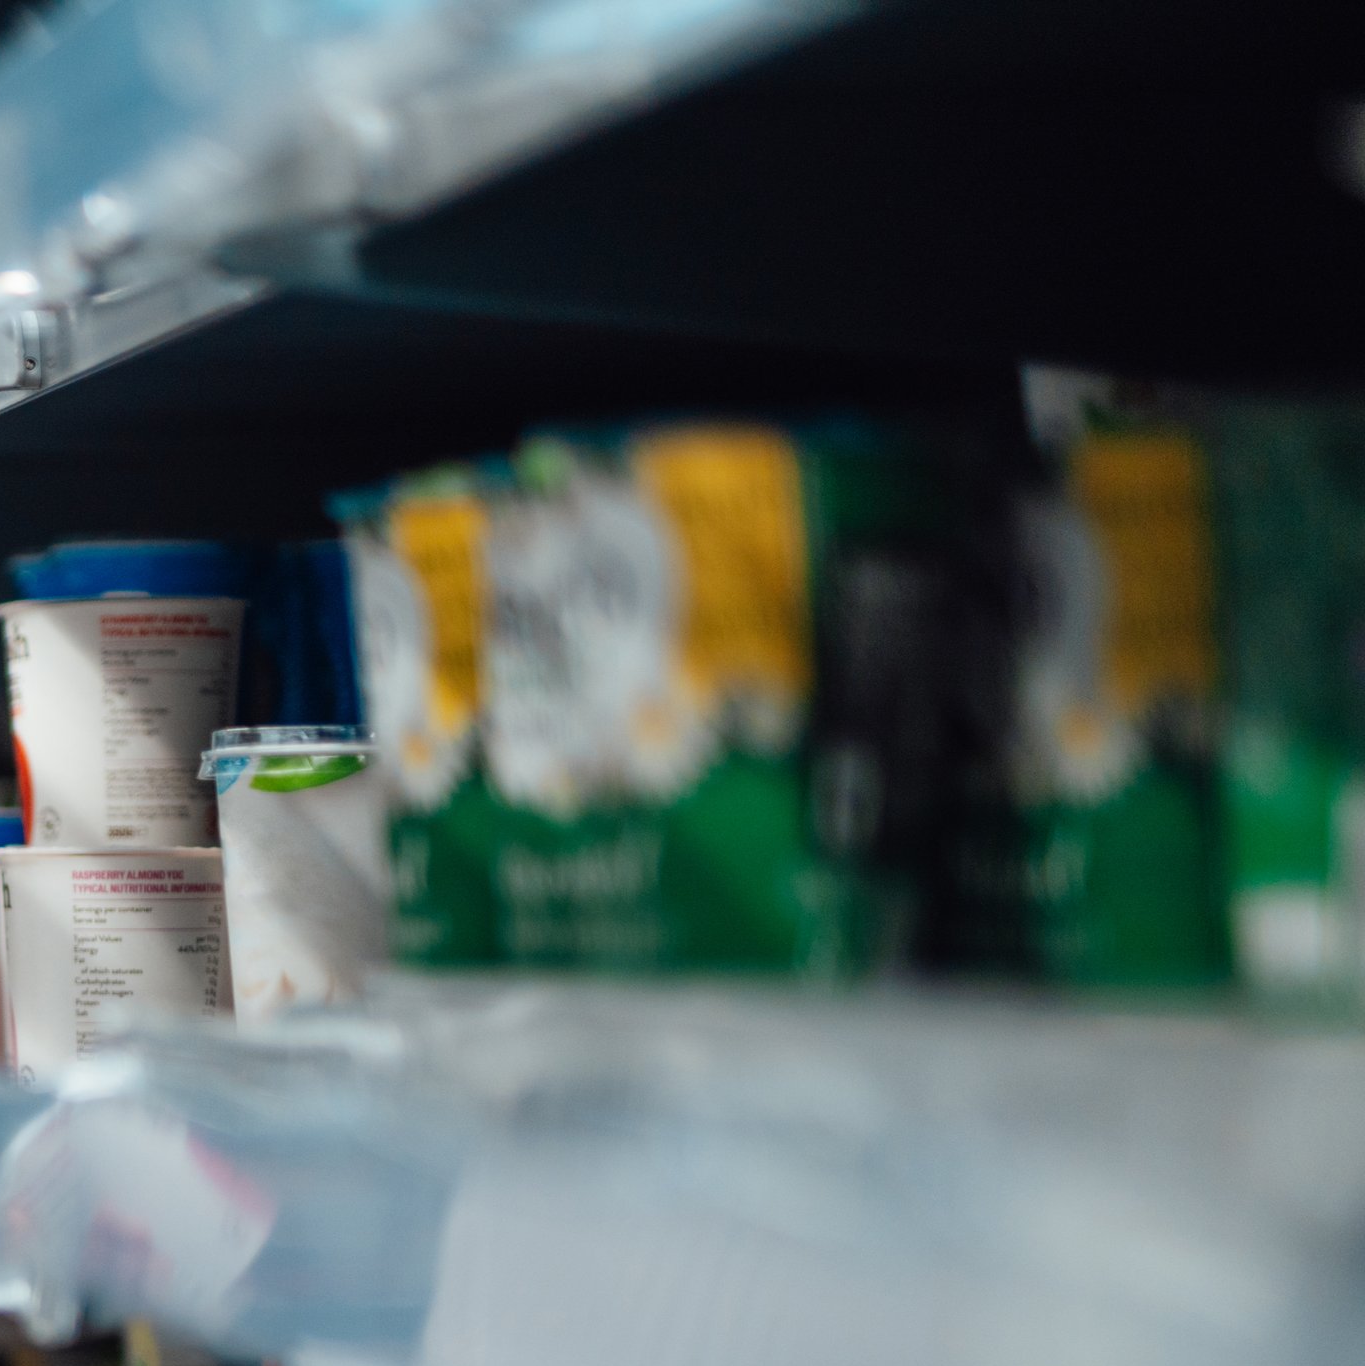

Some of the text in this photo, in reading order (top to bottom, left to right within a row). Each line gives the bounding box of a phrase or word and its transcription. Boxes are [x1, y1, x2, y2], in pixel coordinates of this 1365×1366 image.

[72, 870, 125, 880] RASPBERRY
[127, 870, 165, 880] ALMOND
[73, 884, 108, 893] TYPICAL
[110, 883, 168, 893] NUTRITIONAL
[73, 904, 103, 915] Servings
[117, 904, 153, 913] container
[73, 916, 93, 924] Serve
[73, 934, 98, 944] Typical
[99, 934, 122, 942] Values
[73, 945, 98, 955] Energy
[73, 956, 85, 964] Fat
[81, 967, 144, 975] of which saturates
[74, 978, 126, 987] Carbohydrates
